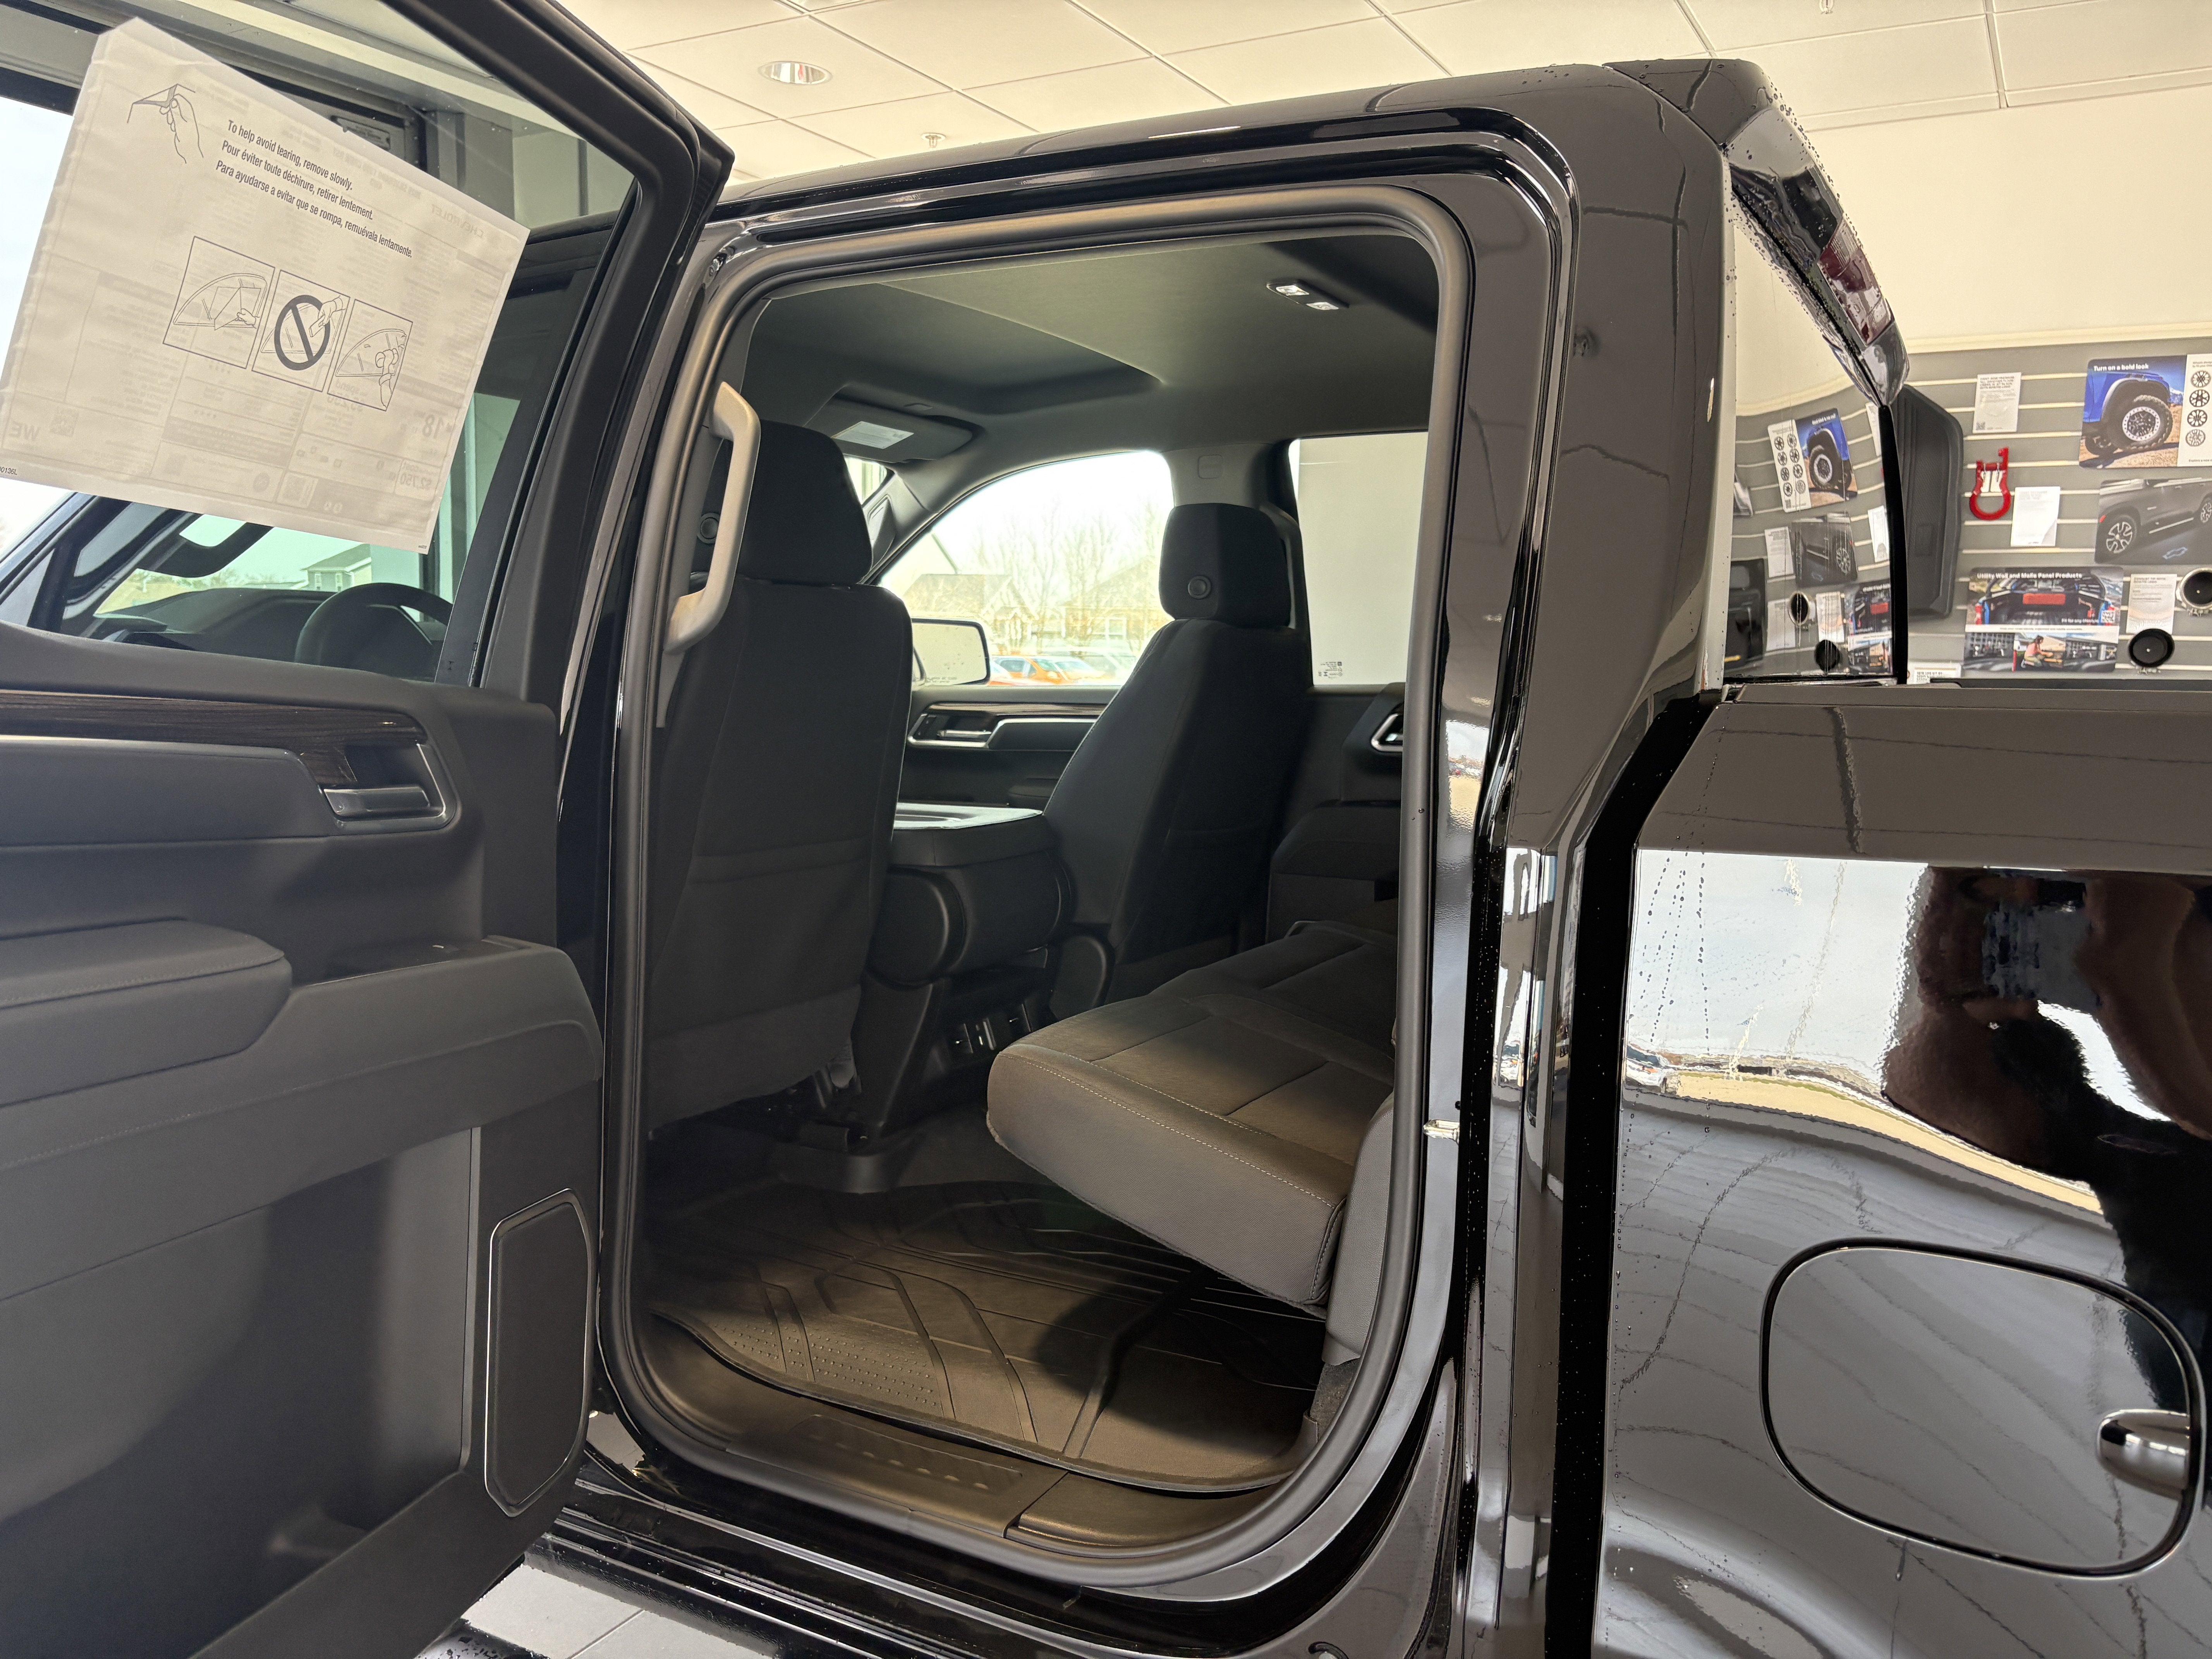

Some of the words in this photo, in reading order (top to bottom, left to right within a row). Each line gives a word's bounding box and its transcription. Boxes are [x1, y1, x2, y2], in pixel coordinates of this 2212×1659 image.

[222, 140, 240, 157] Pour
[242, 149, 263, 167] éviter
[264, 160, 281, 176] toute
[283, 170, 315, 195] déchirure,
[317, 187, 339, 203] retirer
[339, 196, 373, 220] lentement.
[228, 120, 237, 133] To
[239, 125, 255, 143] help
[256, 136, 276, 152] avoid
[277, 145, 301, 167] tearing,
[303, 160, 328, 178] remove
[330, 173, 352, 191] slowly.
[216, 160, 234, 177] Para
[235, 171, 270, 192] ayudarse
[271, 187, 275, 195] a
[277, 190, 295, 204] evitar
[296, 198, 309, 210] que
[310, 204, 318, 215] se
[319, 209, 343, 228] rompa,
[345, 221, 378, 242] remuévala
[379, 235, 412, 258] lentamente.
